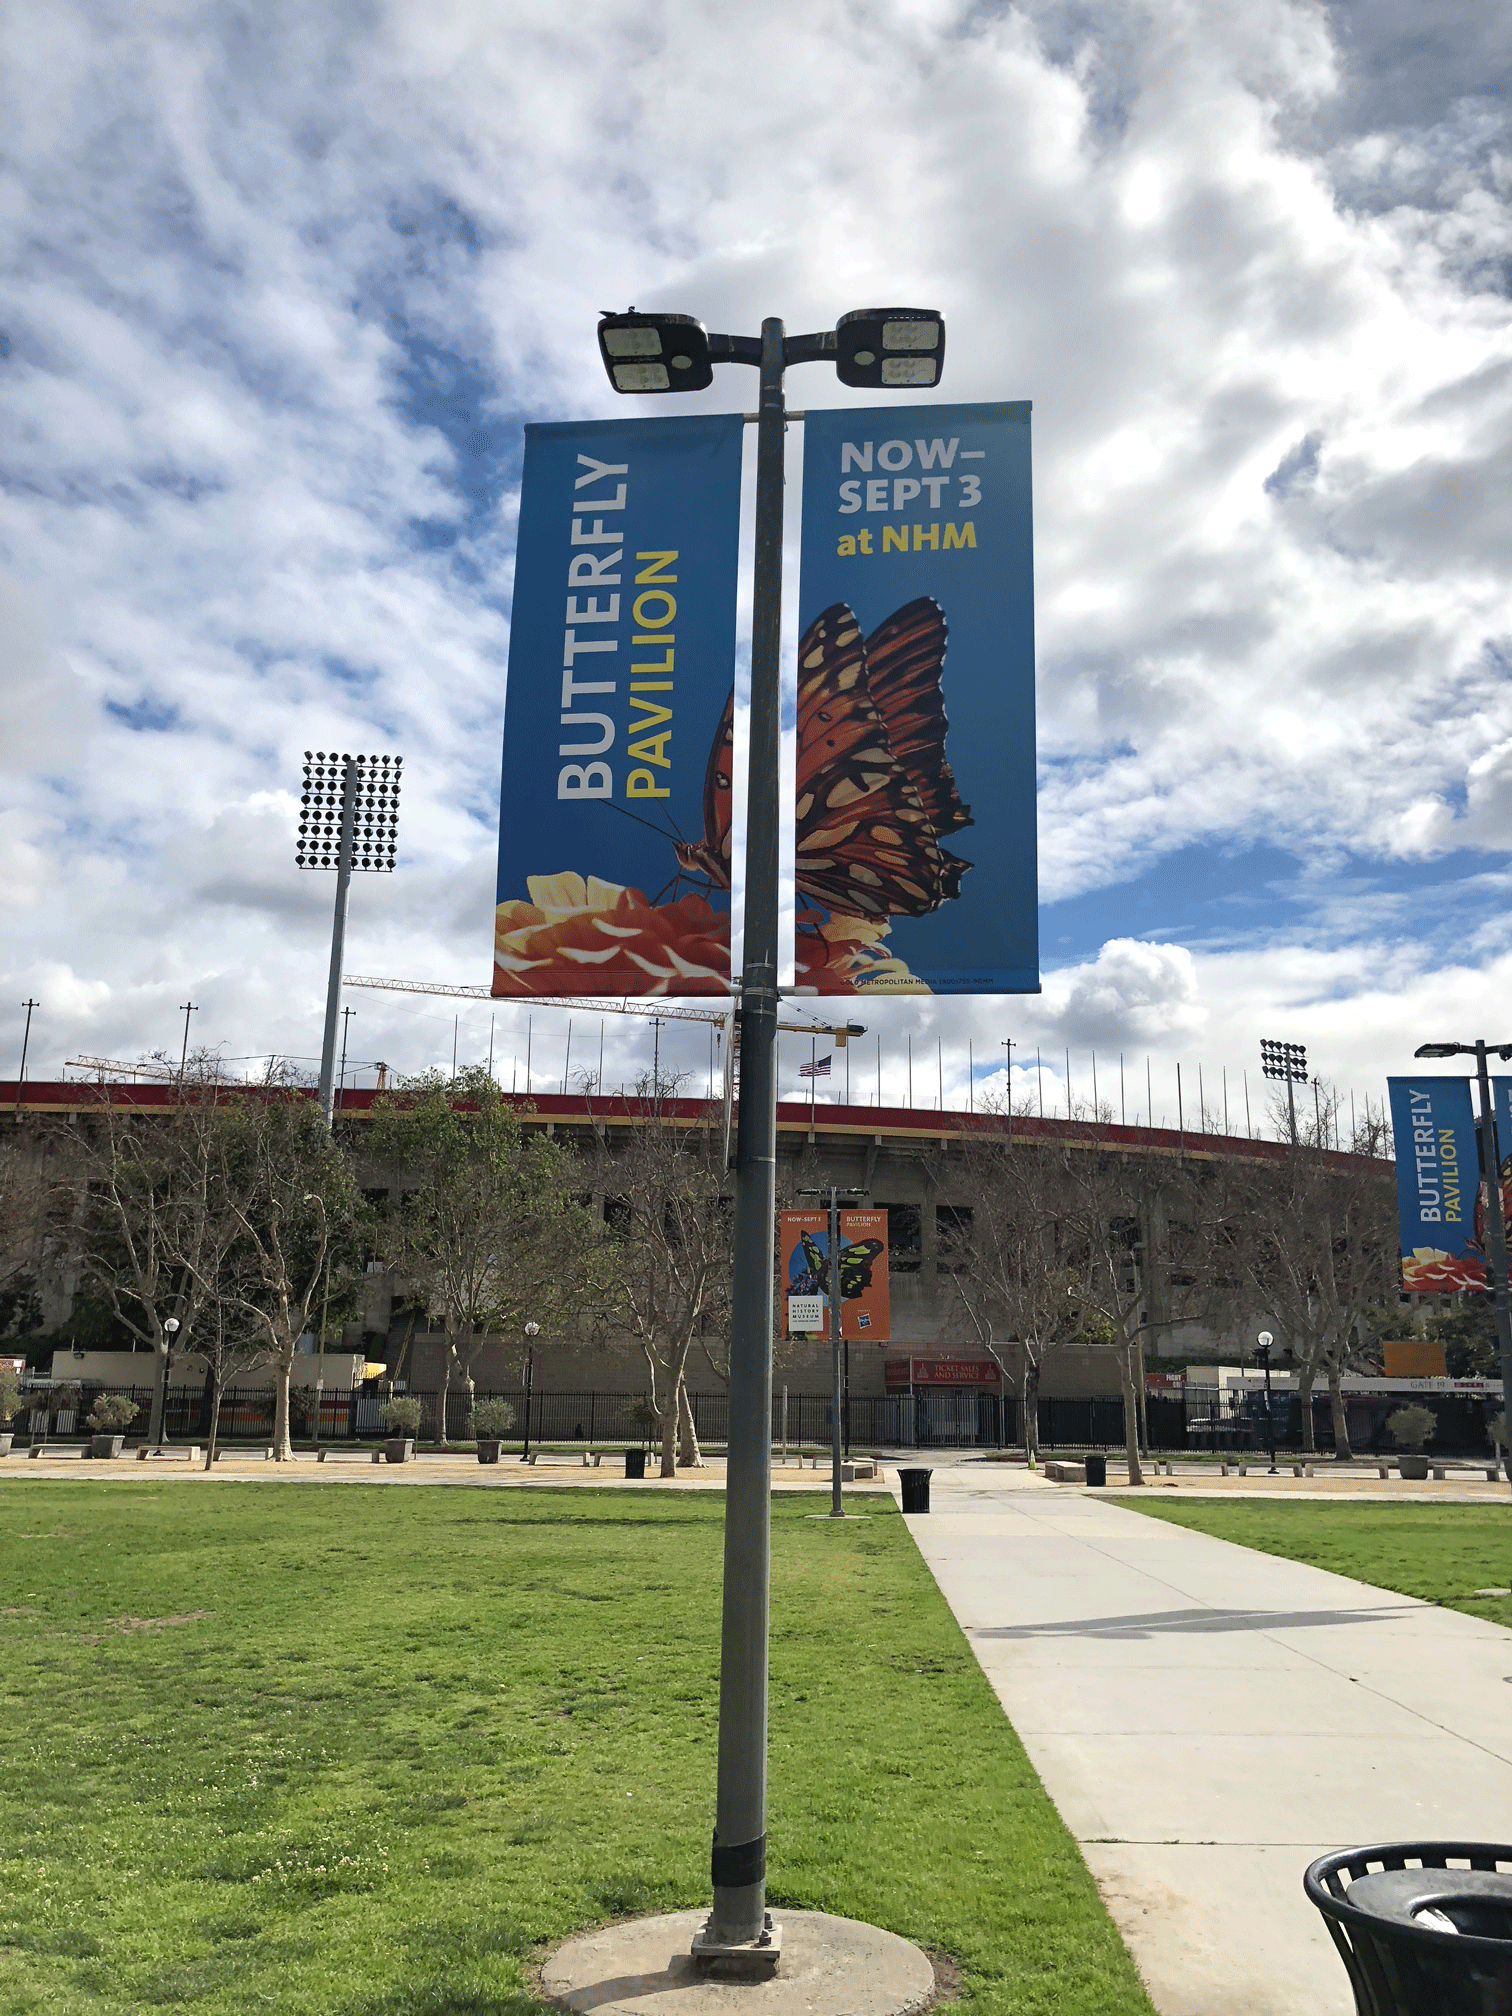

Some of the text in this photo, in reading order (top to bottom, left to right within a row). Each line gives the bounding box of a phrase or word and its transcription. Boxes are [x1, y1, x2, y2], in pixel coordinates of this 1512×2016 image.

[837, 521, 977, 557] at NHM
[838, 474, 982, 514] SEPT 3
[558, 453, 629, 800] BUTTERFLY
[626, 550, 679, 798] PAVILION
[1409, 1089, 1441, 1222] BUTTERFLY
[1438, 1129, 1462, 1222] PAVILION
[934, 1364, 980, 1372] TICKET SALES
